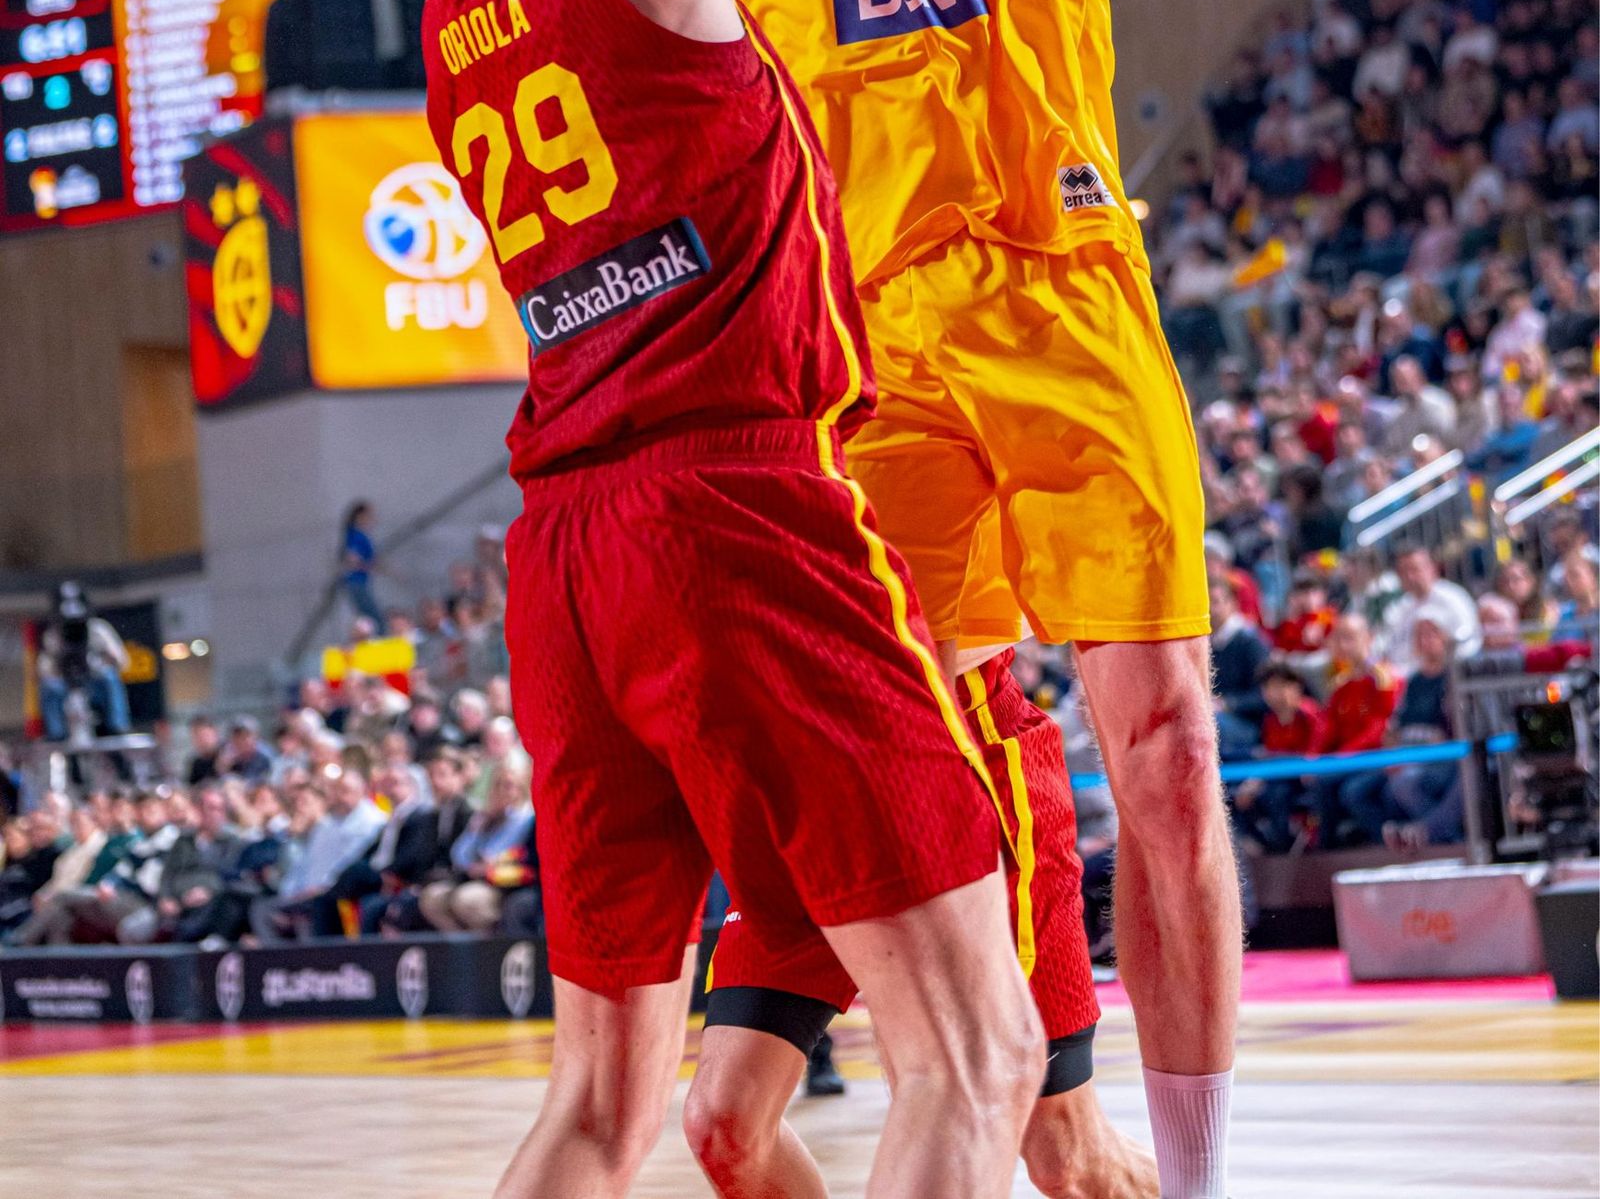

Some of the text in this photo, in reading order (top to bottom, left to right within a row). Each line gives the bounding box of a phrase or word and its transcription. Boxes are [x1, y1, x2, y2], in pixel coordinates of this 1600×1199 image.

[451, 61, 619, 265] 29
[1064, 191, 1103, 208] errea
[526, 234, 700, 341] CaixaBank
